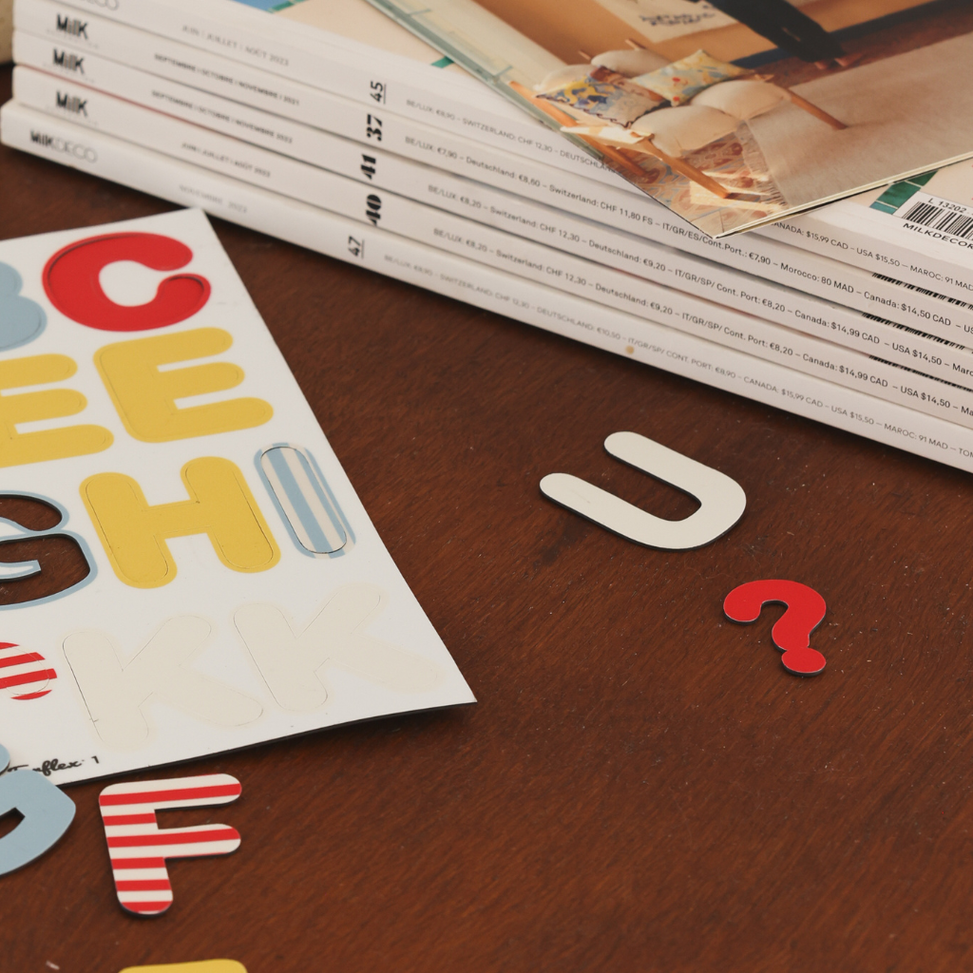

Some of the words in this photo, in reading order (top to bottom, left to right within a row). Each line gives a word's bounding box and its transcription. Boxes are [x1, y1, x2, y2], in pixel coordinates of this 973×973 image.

[366, 113, 383, 141] 37
[370, 80, 383, 103] 45
[462, 118, 516, 141] SWITZERLAND:
[518, 136, 533, 146] CHF
[535, 141, 553, 153] 12,30
[361, 153, 376, 180] 41
[365, 194, 382, 226] 40
[938, 201, 966, 213] 13202
[41, 230, 213, 333] C
[347, 235, 361, 257] 47
[466, 156, 517, 179] Deutschland:
[549, 185, 599, 207] Switzerland:
[600, 202, 617, 213] CHF
[620, 207, 641, 221] 11,80
[642, 215, 653, 225] FS
[749, 252, 771, 266] €7,90
[780, 262, 820, 282] Morocco:
[821, 276, 832, 286] 80
[834, 281, 854, 294] MAD
[864, 291, 899, 309] Canada:
[901, 302, 931, 320] $14,50
[932, 315, 951, 326] CAD
[490, 206, 540, 229] Switzerland:
[540, 223, 556, 233] CHF
[559, 229, 580, 243] 12,30
[589, 239, 642, 263] Deutschland:
[643, 258, 666, 272] €9,20
[717, 283, 739, 297] Cont.
[741, 291, 760, 305] Port:
[762, 298, 786, 313] €8,20
[795, 308, 830, 327] Canada:
[831, 321, 860, 338] $14,99
[862, 333, 880, 344] CAD
[892, 342, 911, 355] USA
[912, 349, 942, 366] $14,50
[768, 221, 805, 236] ANADA:
[807, 231, 829, 244] $15,99
[831, 238, 849, 250] CAD
[857, 248, 873, 259] USA
[875, 252, 900, 267] $15,50
[910, 265, 944, 281] MAROC:
[945, 276, 953, 285] 91
[955, 279, 973, 292] MAD
[496, 249, 545, 272] Switzerland:
[546, 266, 563, 276] CHF
[565, 272, 587, 286] 12,30
[596, 283, 649, 307] Deutschland:
[650, 302, 673, 316] €9,20
[724, 327, 746, 340] Cont.
[748, 334, 768, 348] Port:
[769, 342, 793, 357] €8,20
[802, 353, 838, 371] Canada:
[839, 365, 868, 381] $14,99
[870, 376, 889, 388] CAD
[901, 385, 919, 398] USA
[921, 392, 951, 409] $14,50
[537, 306, 595, 331] DEUTSCHLAND:
[666, 350, 689, 363] CONT.
[691, 359, 714, 372] PORT:
[744, 376, 779, 393] CANADA:
[781, 388, 805, 402] $15,99
[805, 395, 823, 408] CAD
[831, 405, 848, 417] USA
[850, 411, 875, 425] $15,50
[884, 423, 917, 439] MAROC:
[918, 435, 927, 443] 91
[929, 438, 948, 450] MAD
[91, 325, 275, 444] E
[78, 455, 282, 591] H
[538, 430, 747, 552] U
[96, 771, 243, 918] F
